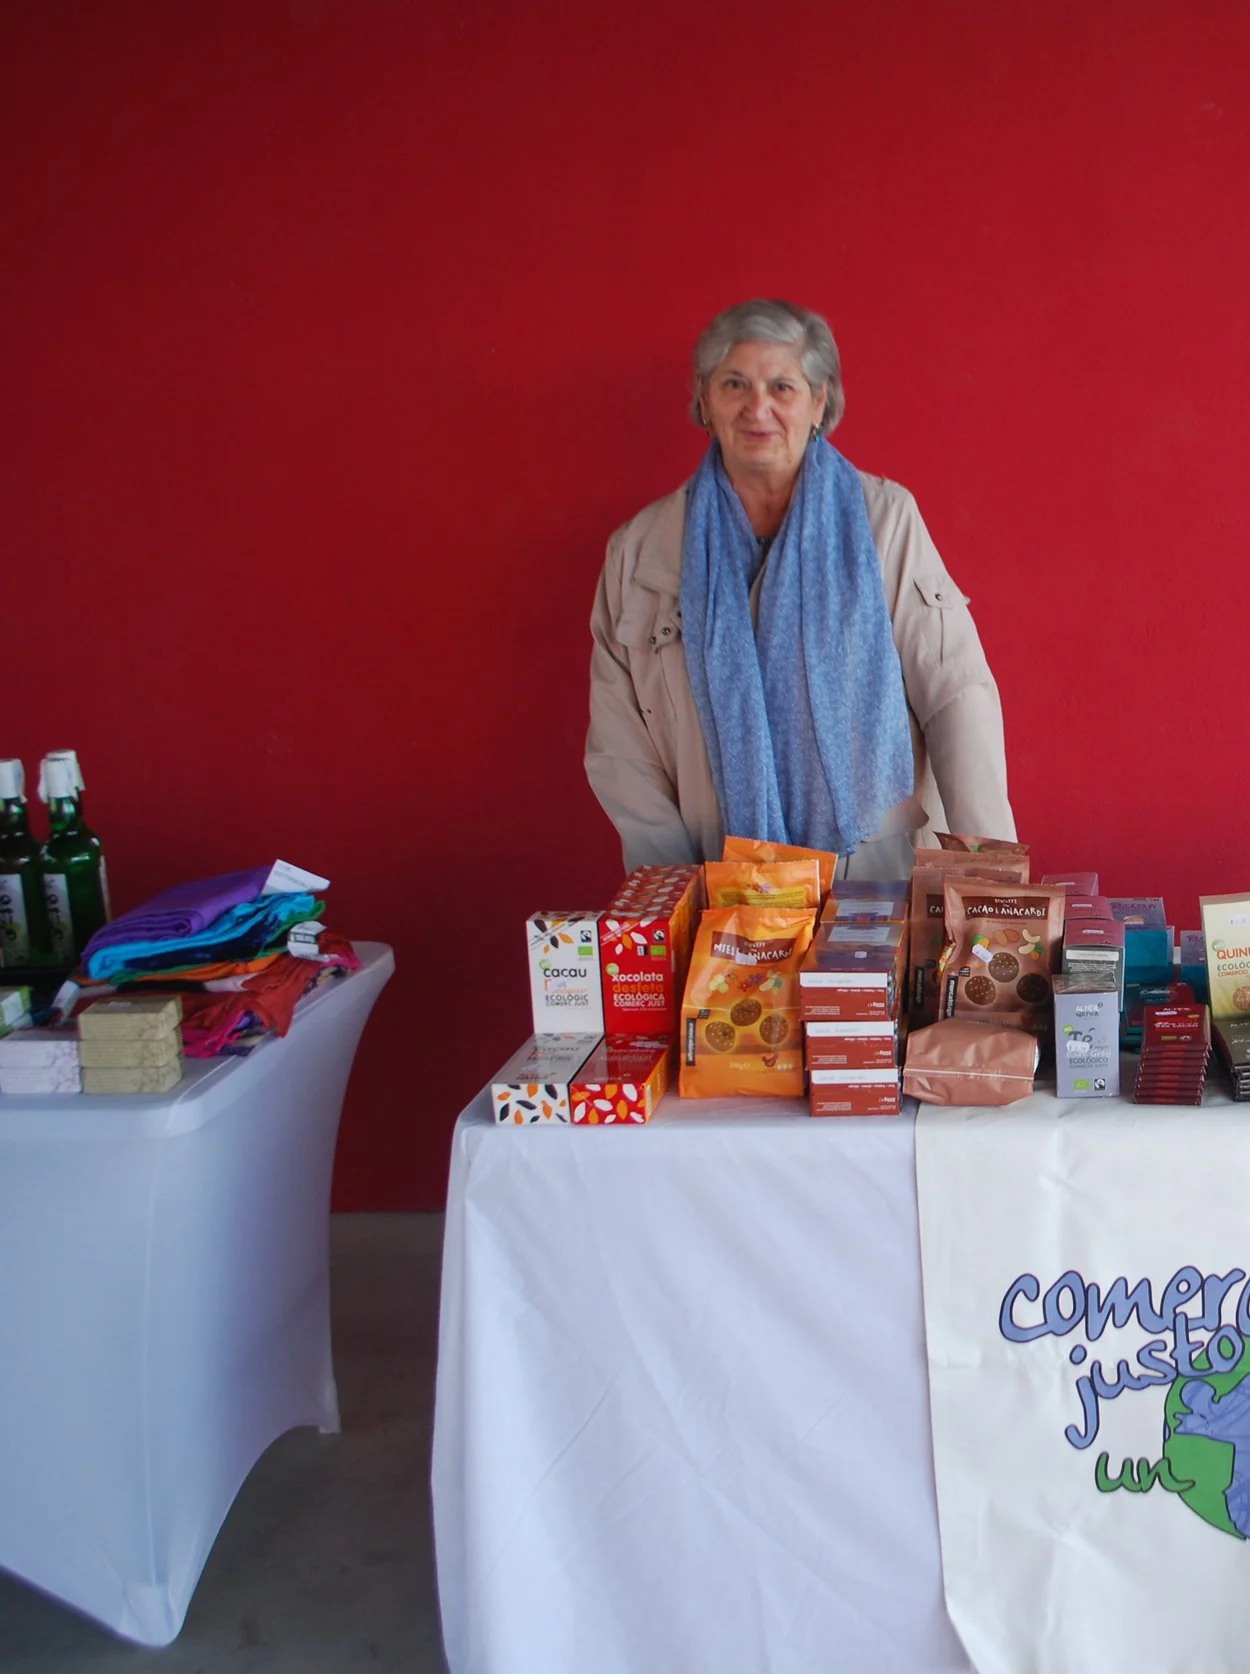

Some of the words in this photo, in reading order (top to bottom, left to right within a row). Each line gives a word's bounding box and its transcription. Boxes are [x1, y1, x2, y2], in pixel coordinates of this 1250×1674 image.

[967, 904, 994, 915] CACAO
[1000, 906, 1046, 917] ANACARDI
[543, 967, 588, 978] cacau
[612, 971, 664, 982] xocolata
[1064, 1312, 1245, 1449] justo
[1095, 1452, 1196, 1492] un
